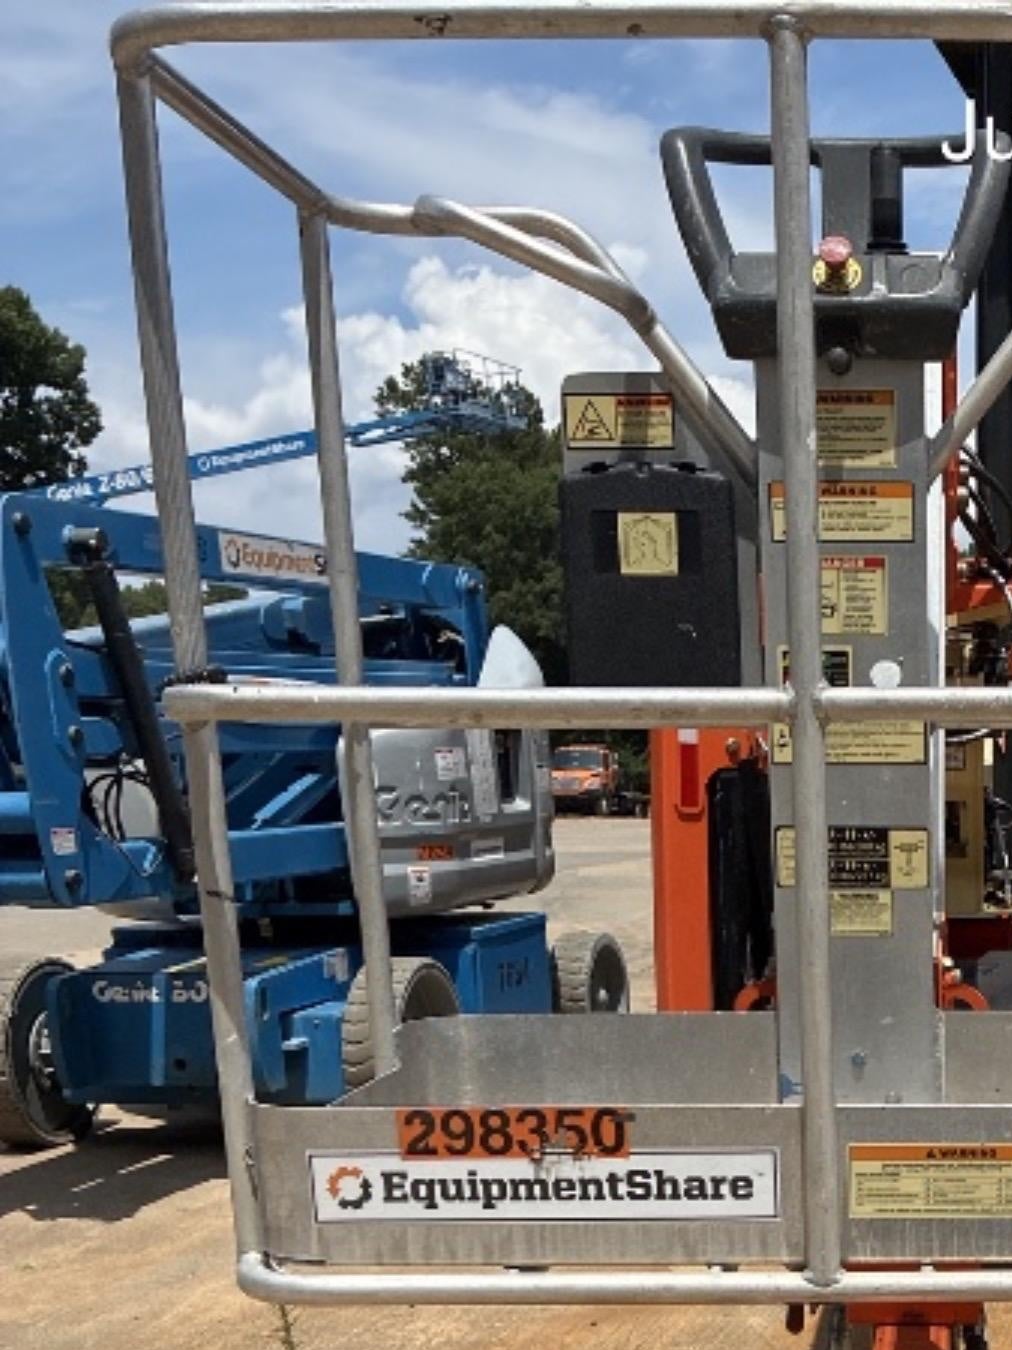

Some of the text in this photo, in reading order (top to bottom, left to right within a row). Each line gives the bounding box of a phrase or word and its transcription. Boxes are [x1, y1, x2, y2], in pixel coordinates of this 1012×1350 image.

[242, 543, 328, 576] EquipmentS
[403, 1107, 627, 1157] 298350
[380, 1169, 755, 1210] EquipmentShare
